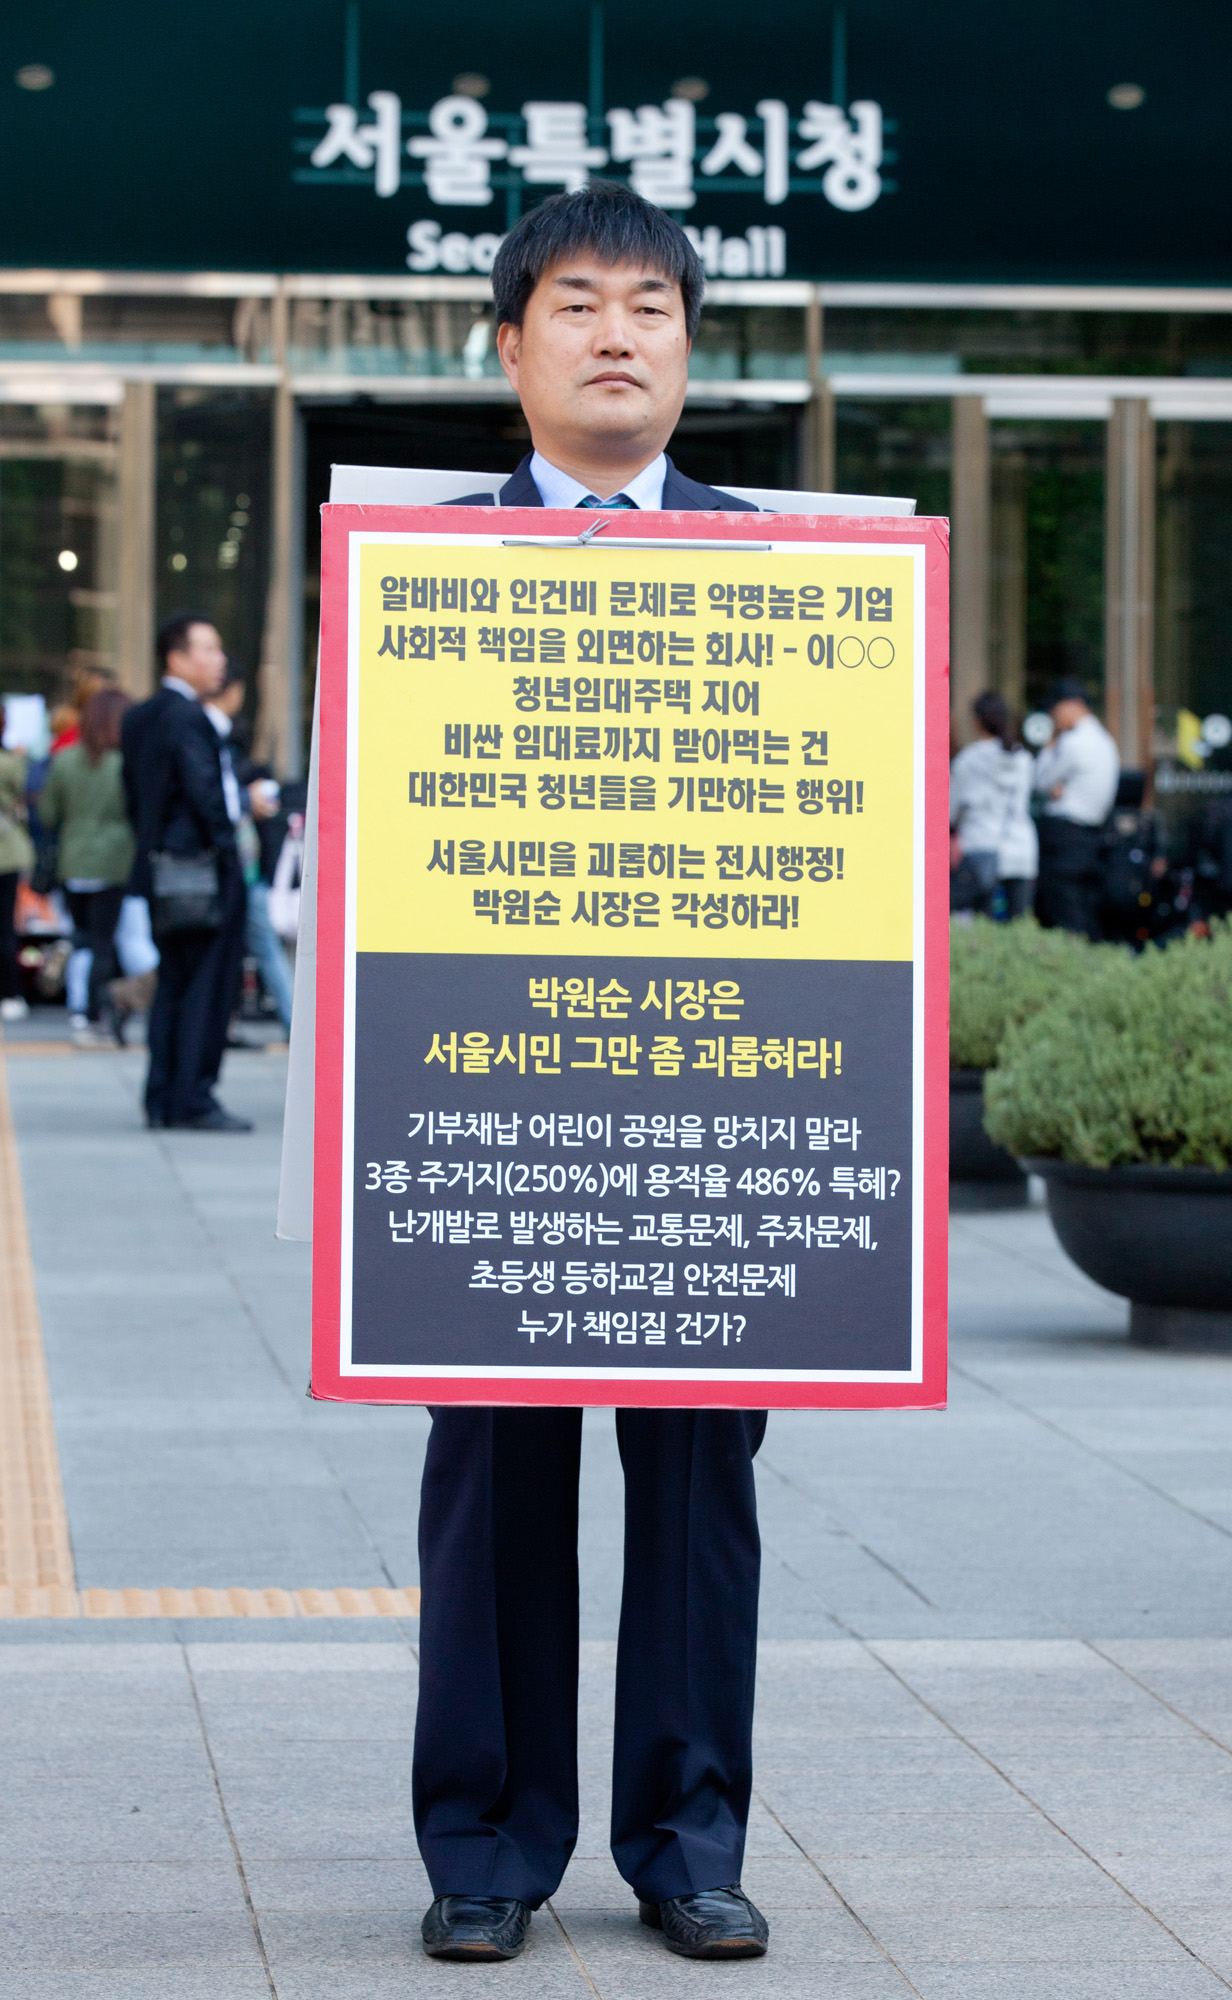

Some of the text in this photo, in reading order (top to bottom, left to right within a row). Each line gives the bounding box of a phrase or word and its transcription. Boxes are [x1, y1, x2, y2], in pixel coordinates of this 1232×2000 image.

[310, 91, 883, 212] 서울특별시청
[381, 576, 892, 622] 알바비와 인건비 문제로 악명높은 기업
[377, 625, 465, 661] 사회적
[478, 627, 565, 663] 책임을
[577, 629, 694, 666] 외면하는
[706, 632, 773, 667] 회사!
[513, 676, 759, 716] 청년임대주택 지어
[445, 724, 828, 765] 비싼 임대료까지 받아먹는 건
[409, 772, 863, 815] 대한민국 청년들을 기만하는 행위!
[427, 840, 844, 882] 서울시민을 괴롭히는 전시행정!
[474, 890, 799, 929] 박원순 시장은 각성하라!
[529, 977, 744, 1021] 박원순 시장은
[424, 1032, 842, 1079] 서울시민 그만 좀 괴롭혀라!
[408, 1111, 862, 1151] 기부채납 어린이 공원을 망치지 말라
[365, 1160, 412, 1194] 3종
[644, 1164, 731, 1198] 용적율
[736, 1168, 820, 1196] 486%
[829, 1167, 901, 1200] 특혜?
[389, 1209, 878, 1250] 난개발로 발생하는 교통문제, 주차문제,
[469, 1260, 796, 1297] 초등생 등하교길 안전문제
[517, 1310, 746, 1346] 누가 책임질 건가?
